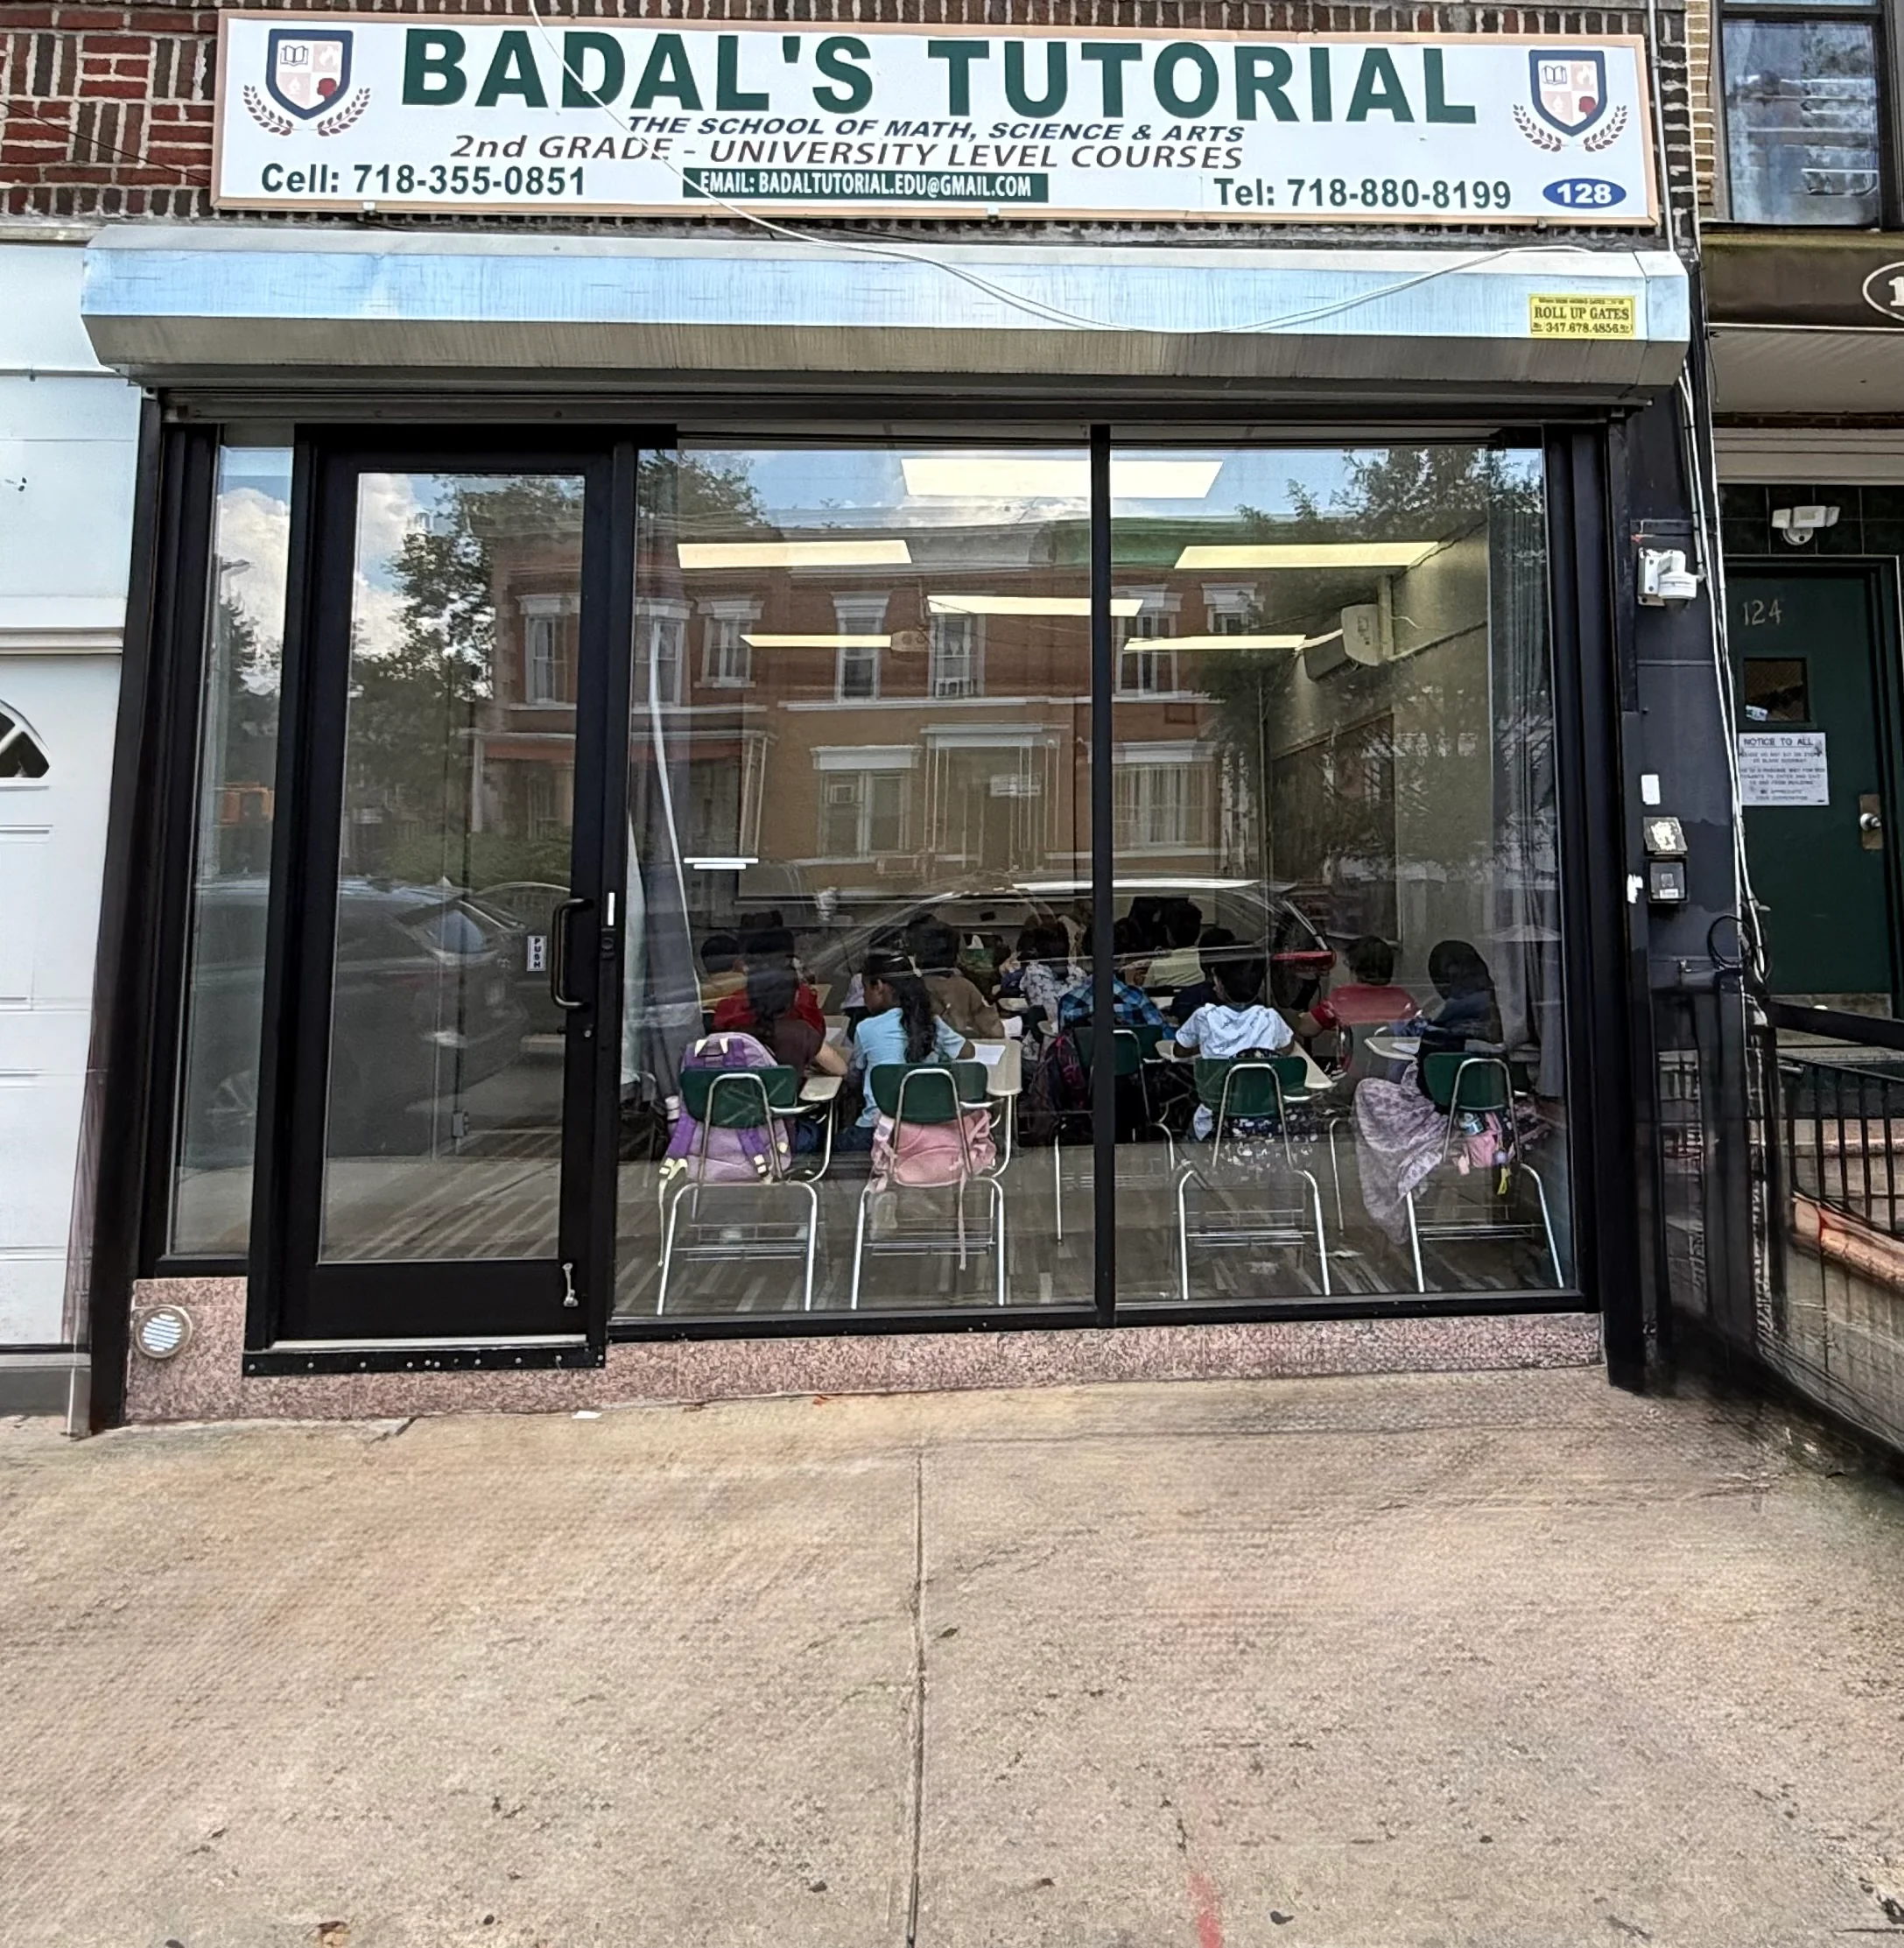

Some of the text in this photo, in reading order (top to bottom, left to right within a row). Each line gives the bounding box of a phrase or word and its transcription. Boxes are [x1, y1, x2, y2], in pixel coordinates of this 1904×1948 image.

[401, 27, 1476, 124] BADAL'S TUTORIAL
[628, 116, 1245, 142] THE SCHOOL OF MATH, SCIENCE & ARTS
[450, 135, 528, 158] 2nd
[538, 136, 673, 160] GRADE
[710, 140, 938, 166] UNIVERSITY
[948, 144, 1057, 167] LEVEL
[1071, 145, 1243, 169] COURSES
[262, 163, 585, 196] Cell: 718-355-0851
[699, 172, 1032, 199] EMAIL: BADALTUTORIAL.EDU@GMAIL.COM
[1213, 178, 1512, 209] Tel: 718-880-8199
[1556, 183, 1612, 204] 128
[1534, 306, 1629, 320] ROLL UP GATES
[1743, 599, 1782, 626] 124
[1743, 737, 1814, 747] NOTICE TO ALL
[533, 938, 542, 968] PUSH
